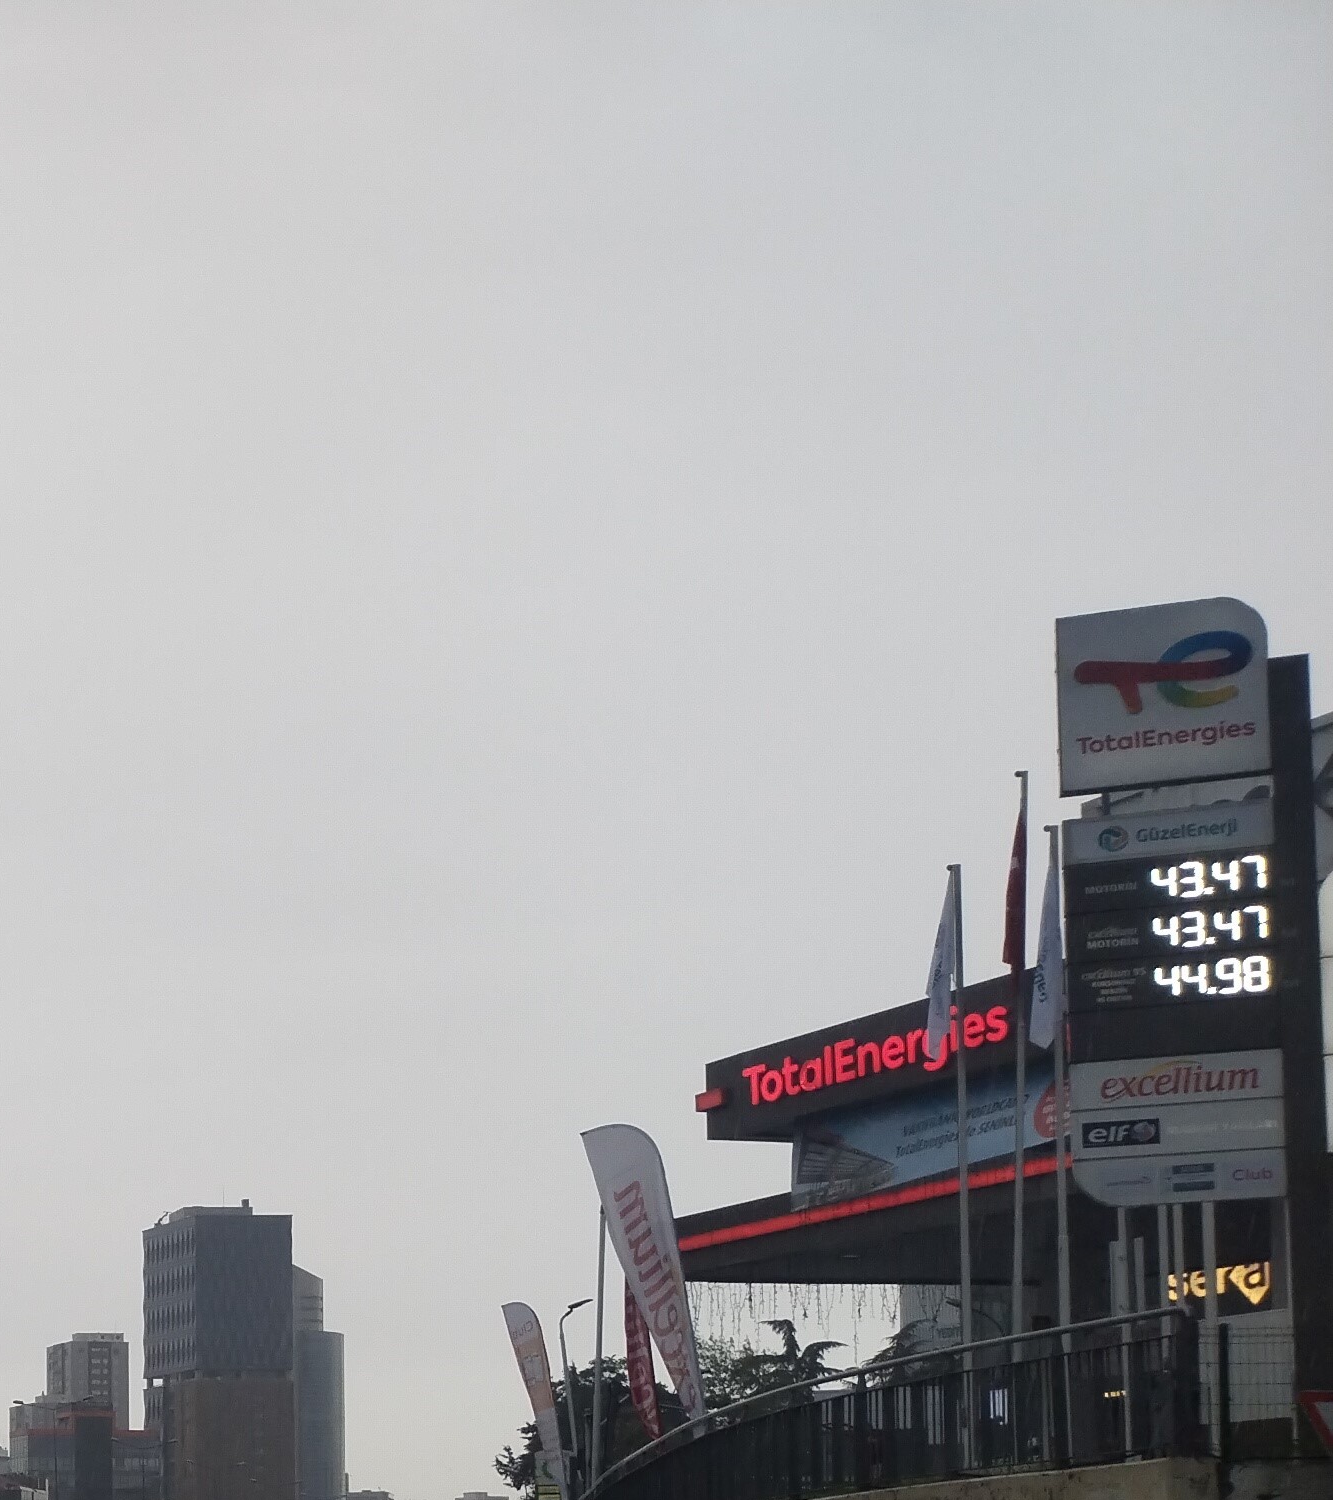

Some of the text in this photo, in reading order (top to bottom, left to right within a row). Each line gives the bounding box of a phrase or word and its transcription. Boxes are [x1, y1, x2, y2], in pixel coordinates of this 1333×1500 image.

[1076, 720, 1256, 755] TotalEnergies
[1136, 818, 1238, 843] GüzelEnerji
[1149, 853, 1270, 898] 43.47
[1151, 904, 1271, 948] 43.47
[1152, 955, 1273, 997] 44.98
[742, 1005, 1008, 1106] TotalEnergies
[1101, 1066, 1259, 1102] excellium
[1088, 1126, 1130, 1143] elf
[1233, 1166, 1274, 1181] Club
